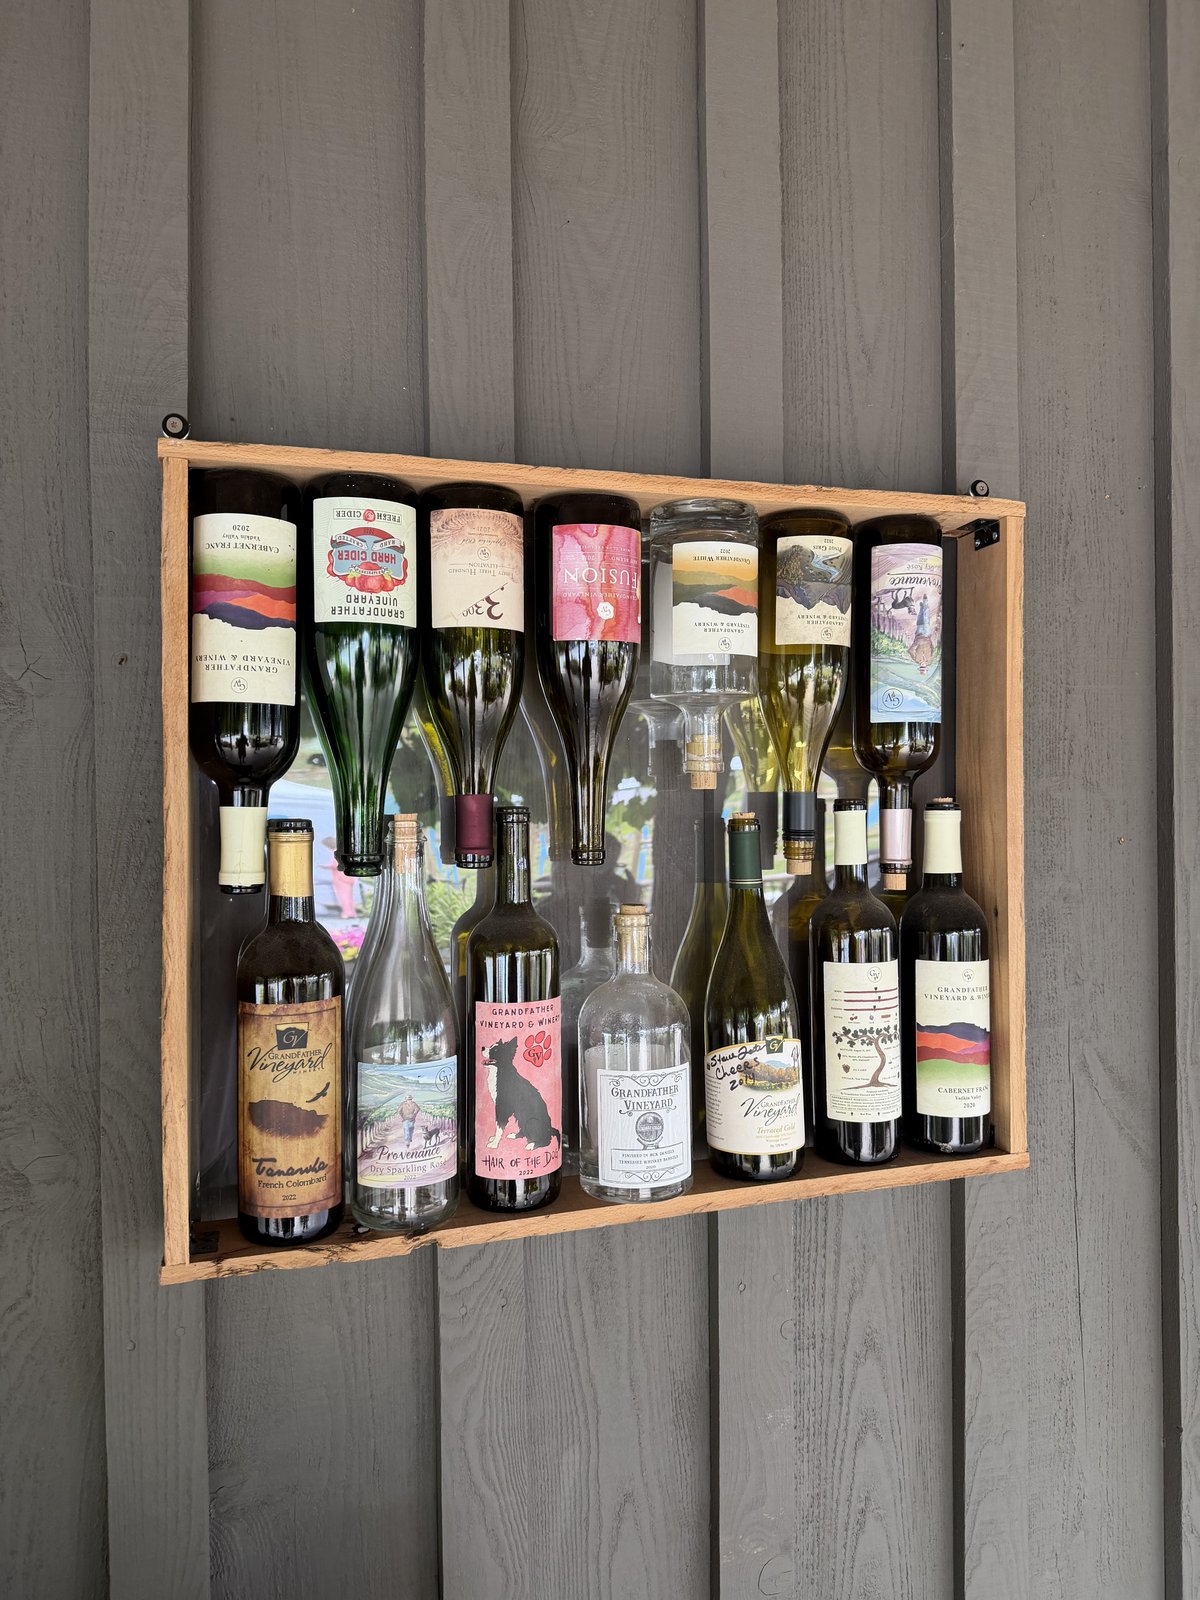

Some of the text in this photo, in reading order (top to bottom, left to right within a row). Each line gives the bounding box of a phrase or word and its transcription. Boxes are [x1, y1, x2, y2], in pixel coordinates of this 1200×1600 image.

[335, 510, 400, 523] FRESH CIDER
[232, 524, 250, 532] 2020
[337, 535, 395, 548] HAND CRAFTED
[205, 542, 279, 554] CABERNET FRANC
[338, 550, 396, 564] HARD CIDER
[715, 556, 750, 565] GRANDFATHER
[564, 567, 637, 588] FUSION
[346, 594, 398, 606] VINEYARD
[331, 606, 404, 619] GRANDFATHER
[242, 655, 290, 665] VINEYARD
[205, 664, 278, 674] GRANDFATHER
[492, 1004, 554, 1016] GRANDFATHER
[480, 1020, 524, 1029] VINEYARD
[268, 1049, 322, 1060] GRANDFATHER
[248, 1043, 333, 1083] Vineyard
[611, 1085, 679, 1098] GRANDFATHER
[624, 1098, 673, 1110] VINEYARD
[741, 1093, 800, 1126] Vineyard
[377, 1146, 440, 1161] Provenance
[482, 1151, 559, 1172] HAIR OF THE DOG
[370, 1165, 384, 1175] Dry
[387, 1164, 427, 1175] Sparkling
[258, 1175, 327, 1188] French Colombard
